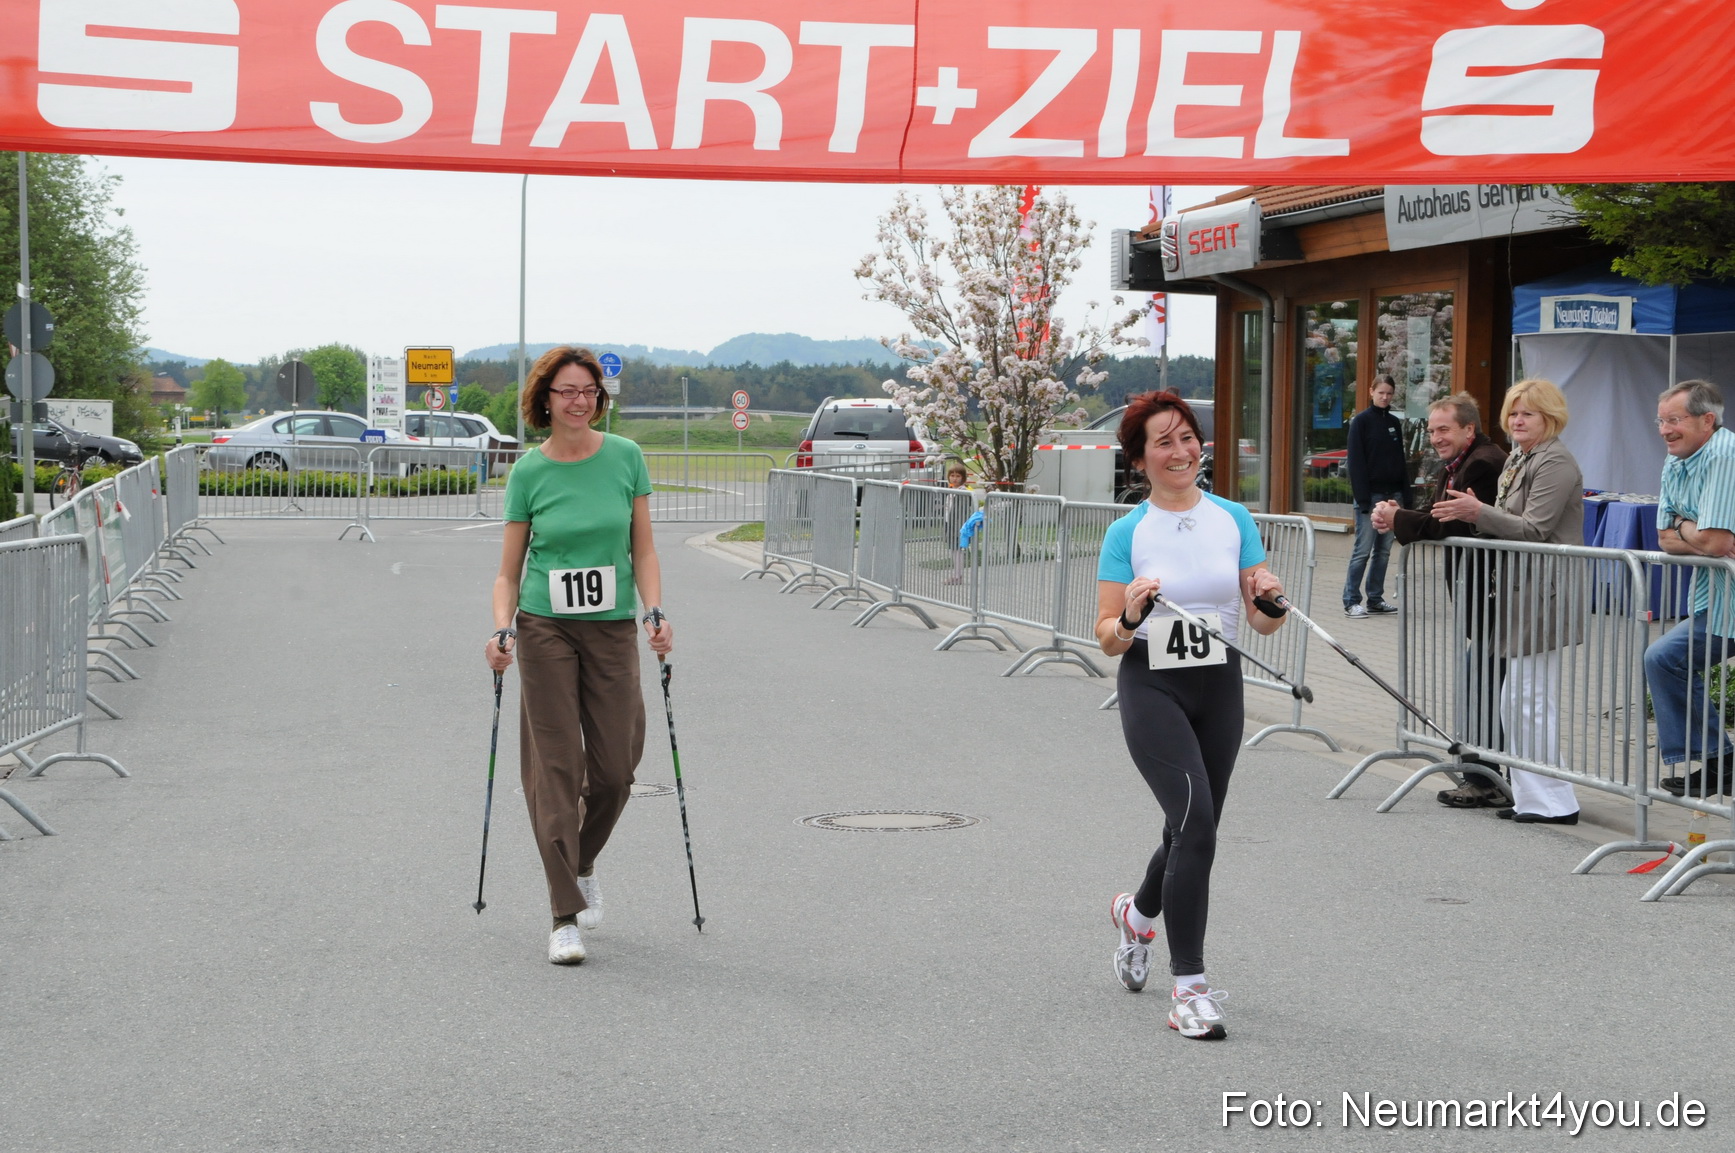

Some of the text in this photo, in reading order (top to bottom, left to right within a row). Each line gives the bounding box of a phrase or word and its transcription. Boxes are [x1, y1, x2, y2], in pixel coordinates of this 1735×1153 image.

[1398, 187, 1471, 224] Autohaus
[1188, 222, 1240, 255] SEAT
[411, 361, 449, 370] Neumarkt
[736, 395, 746, 405] 60
[561, 569, 603, 608] 119
[1166, 617, 1211, 661] 49
